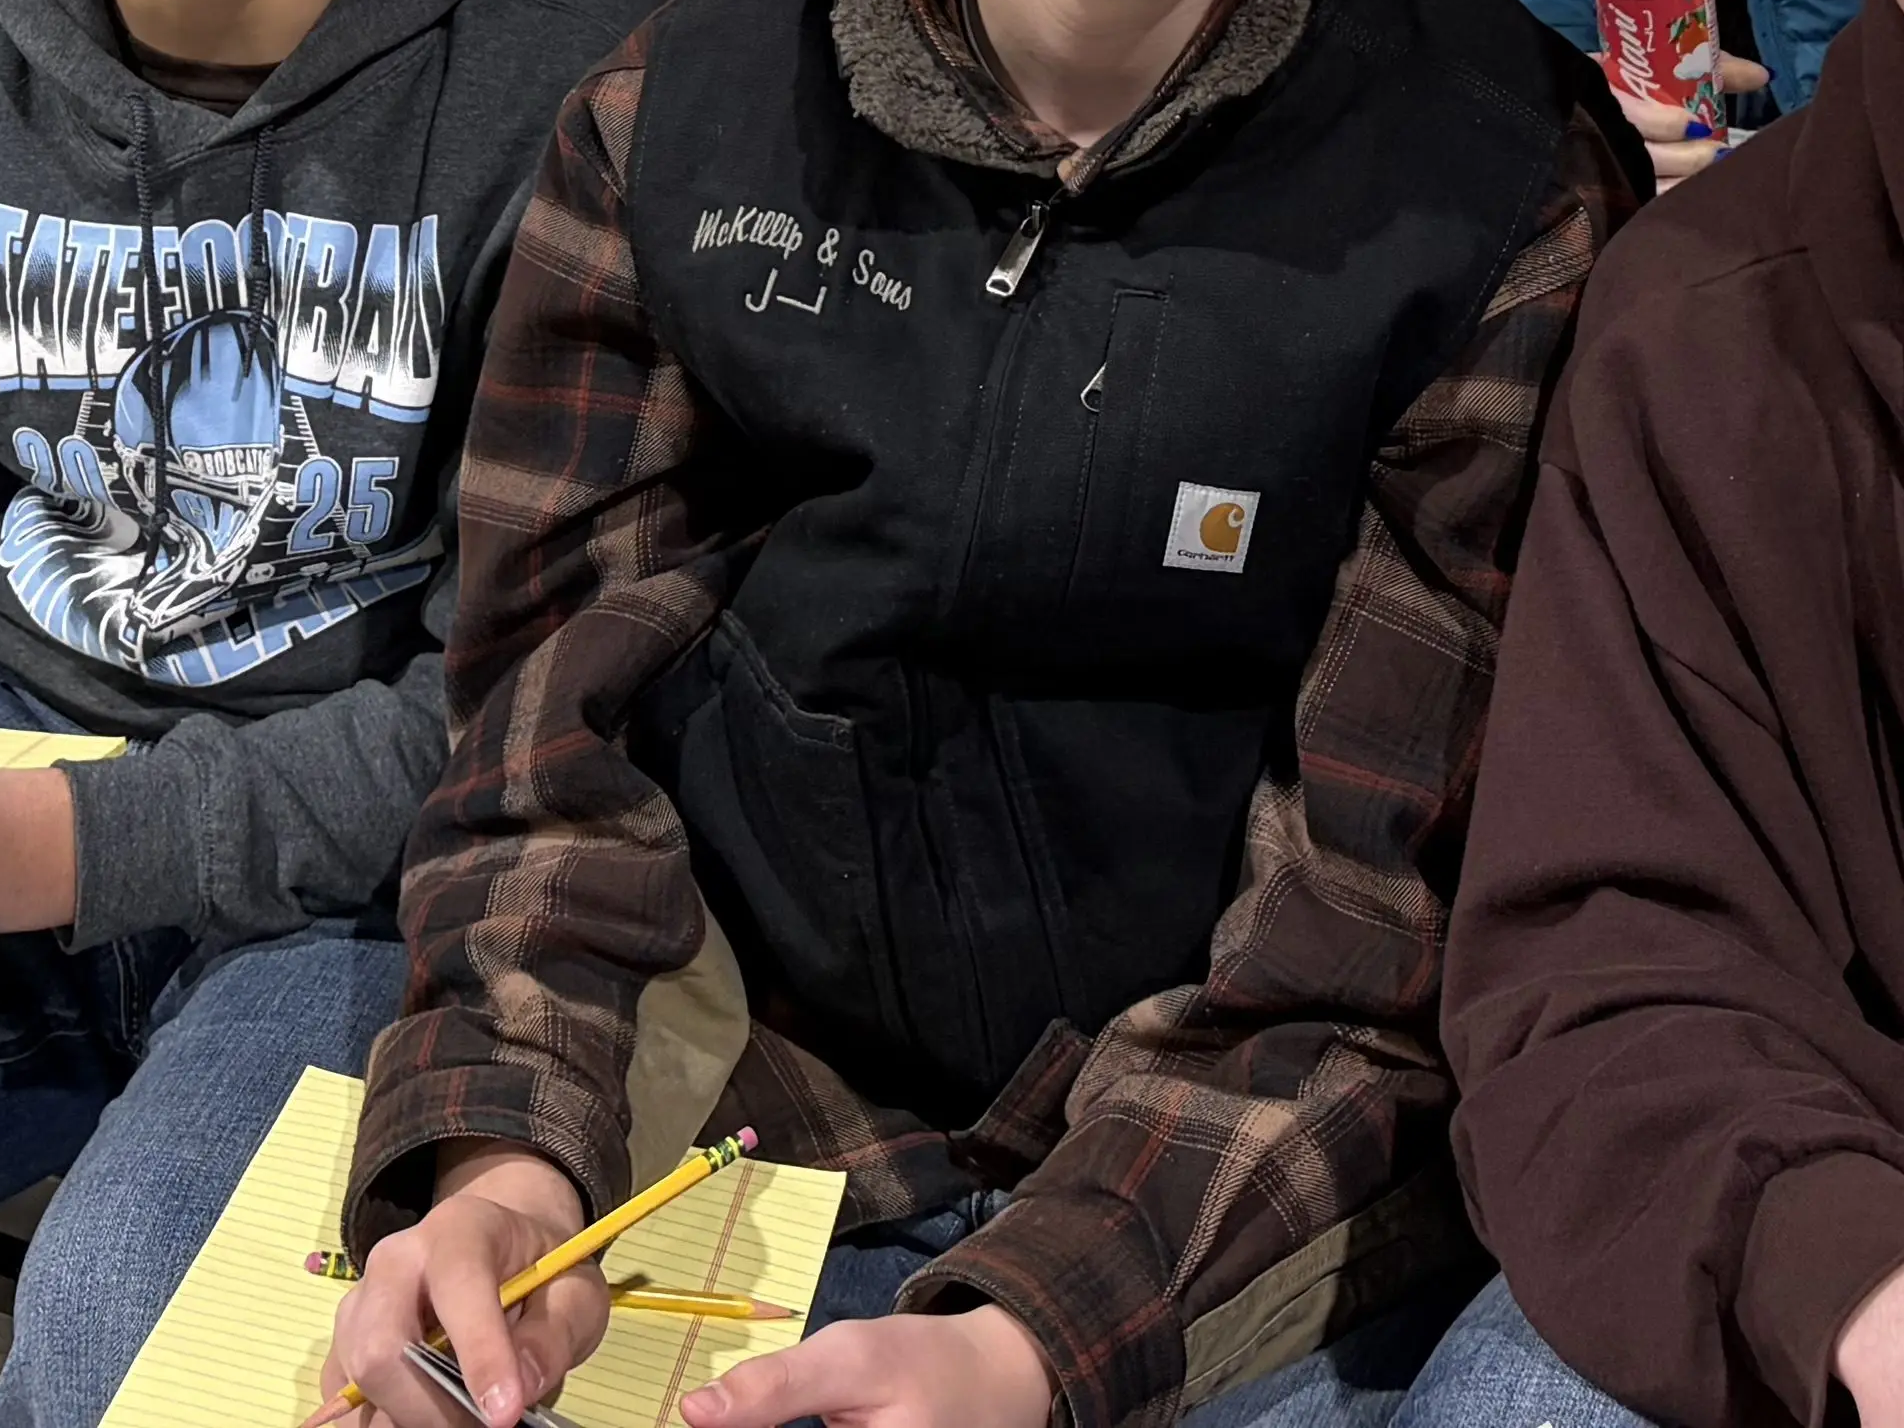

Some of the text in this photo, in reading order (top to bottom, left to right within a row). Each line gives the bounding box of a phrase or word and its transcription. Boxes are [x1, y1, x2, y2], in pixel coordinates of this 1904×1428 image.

[692, 205, 913, 311] McKillip & Sons
[286, 455, 400, 556] 25
